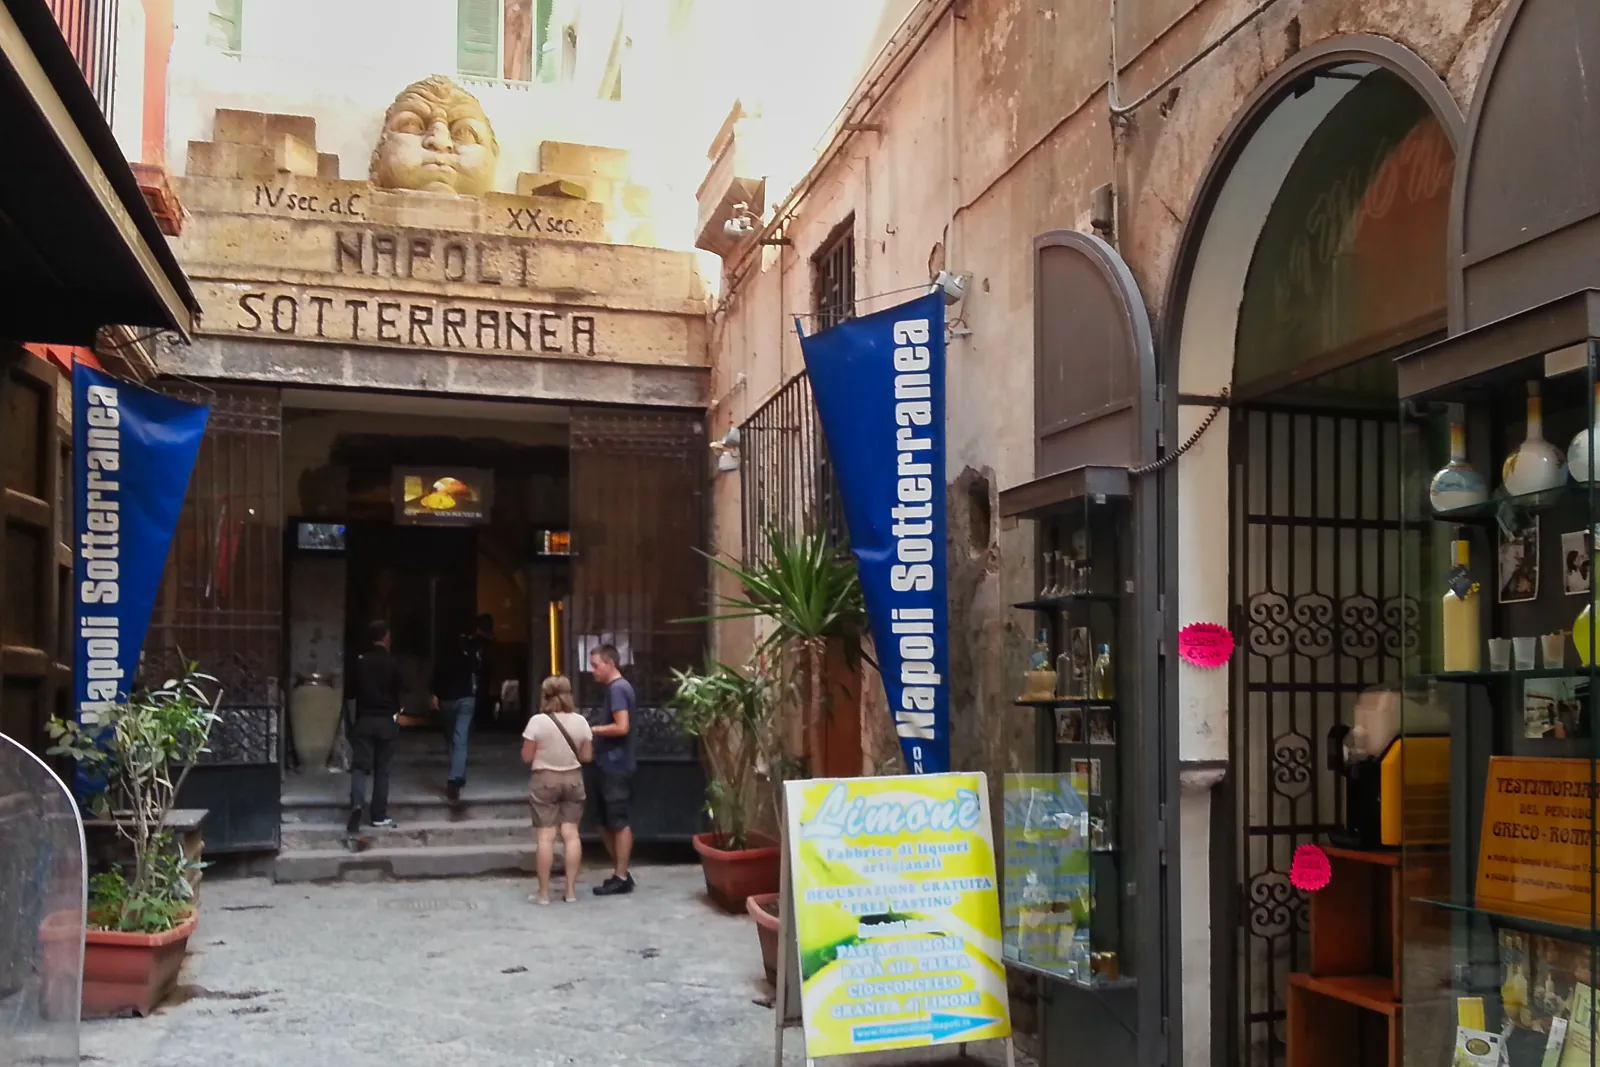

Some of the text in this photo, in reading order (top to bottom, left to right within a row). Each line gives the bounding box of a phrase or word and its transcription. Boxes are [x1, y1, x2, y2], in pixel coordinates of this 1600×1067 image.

[255, 181, 284, 208] IV
[287, 194, 324, 213] sec.
[506, 208, 580, 235] XX sec.
[335, 230, 530, 287] NAPOLI
[237, 292, 596, 357] SOTTERRANEA
[81, 384, 120, 603] Sotterranea
[891, 318, 941, 740] Napoli Sotterranea
[802, 783, 980, 839] Limonè
[827, 840, 969, 861] Fabbrica di liquori
[862, 858, 942, 873] artigianali
[806, 883, 917, 901] DEGUSTAZIONE
[922, 878, 992, 893] GRATUITA
[892, 896, 952, 911] TASTING
[918, 954, 971, 972] CREMA
[924, 991, 981, 1010] LIMONE
